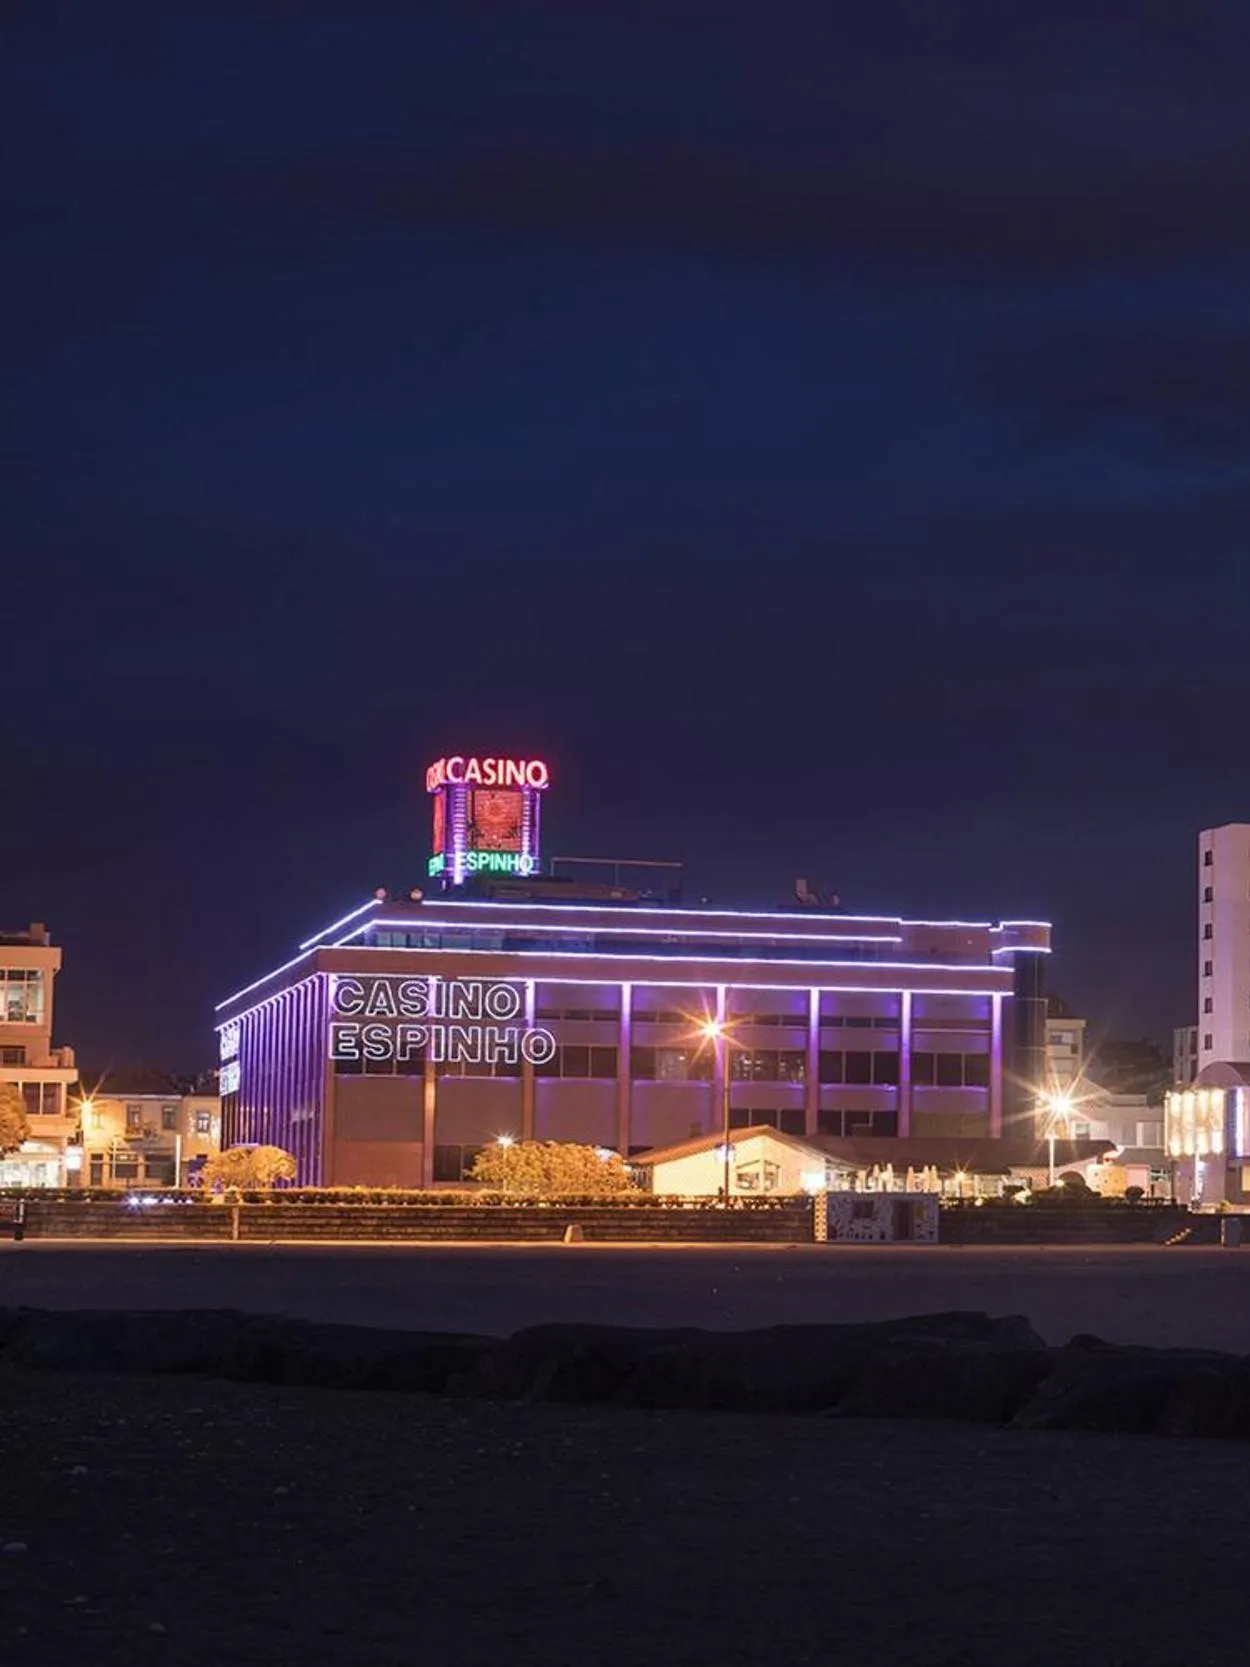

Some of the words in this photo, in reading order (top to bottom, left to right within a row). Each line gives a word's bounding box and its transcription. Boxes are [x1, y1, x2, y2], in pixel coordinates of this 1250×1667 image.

[446, 756, 548, 788] CASINO
[456, 851, 534, 873] ESPINHO
[332, 978, 520, 1021] CASINO
[328, 1022, 556, 1065] ESPINHO
